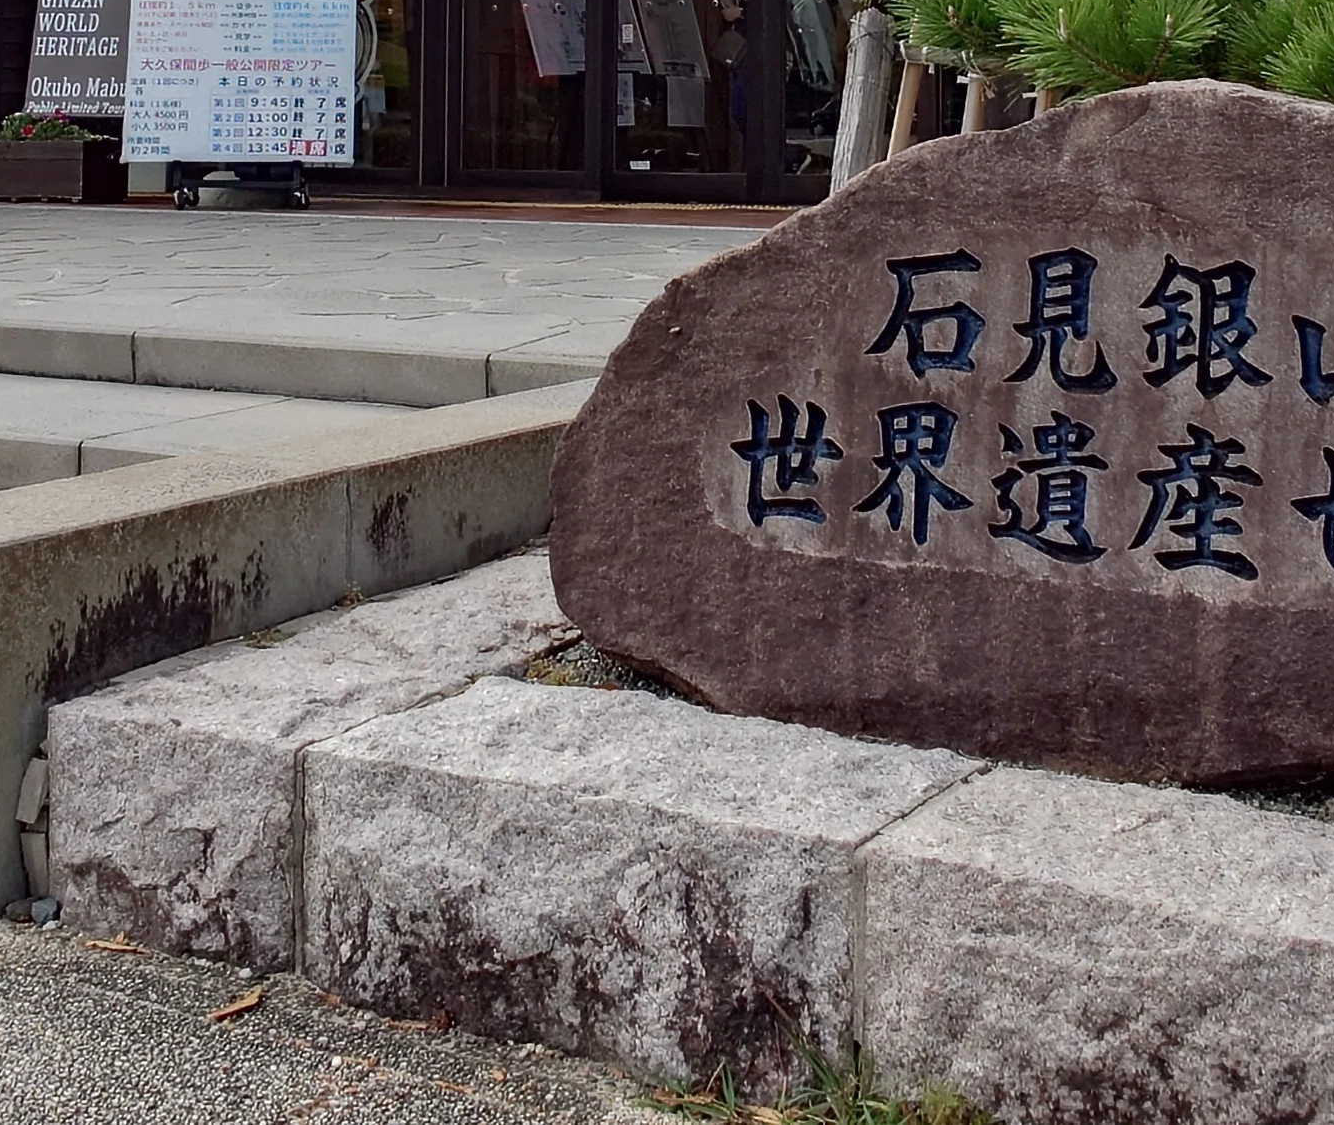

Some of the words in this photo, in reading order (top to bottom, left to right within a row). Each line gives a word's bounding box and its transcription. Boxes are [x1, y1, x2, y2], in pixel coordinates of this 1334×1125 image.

[39, 12, 99, 32] WORLD
[34, 37, 120, 56] HERITAGE
[141, 58, 336, 71] 大久保間歩一般公開限定ツアー
[31, 76, 81, 97] Okubo
[60, 100, 100, 114] Limited
[250, 97, 288, 108] 9:45
[132, 111, 151, 119] 大人
[248, 112, 288, 123] 11:00
[131, 122, 151, 131] 小人
[248, 127, 288, 137] 12:30
[248, 142, 288, 153] 13:45
